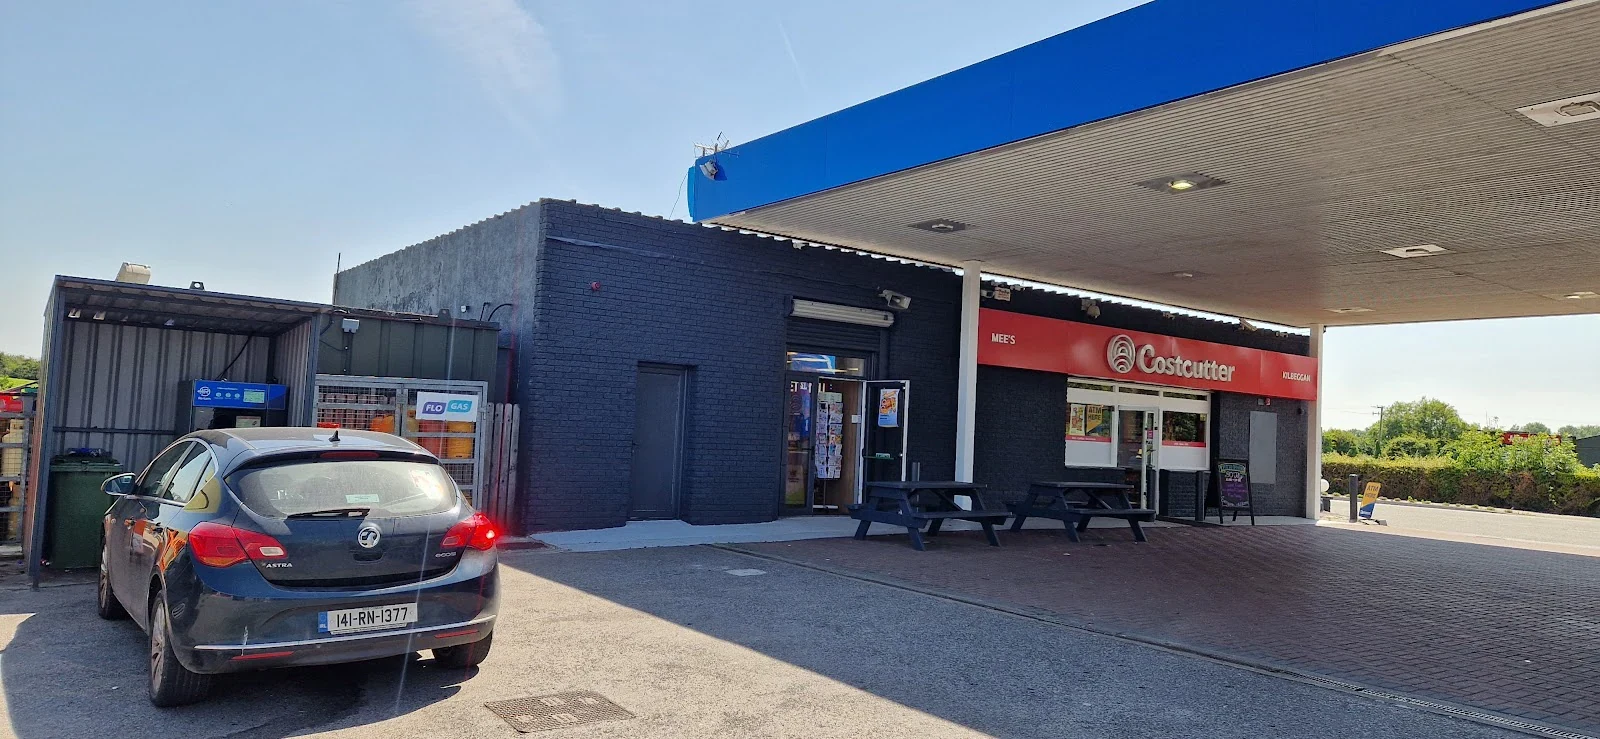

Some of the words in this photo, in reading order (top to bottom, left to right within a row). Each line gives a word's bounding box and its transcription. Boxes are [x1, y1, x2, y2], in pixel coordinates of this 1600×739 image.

[991, 332, 1016, 345] MEE'S
[1136, 344, 1236, 382] Costcutter
[425, 404, 443, 412] FLO
[450, 402, 468, 410] GAS
[1088, 405, 1102, 414] ATM
[336, 606, 408, 628] 141-RN-1377
